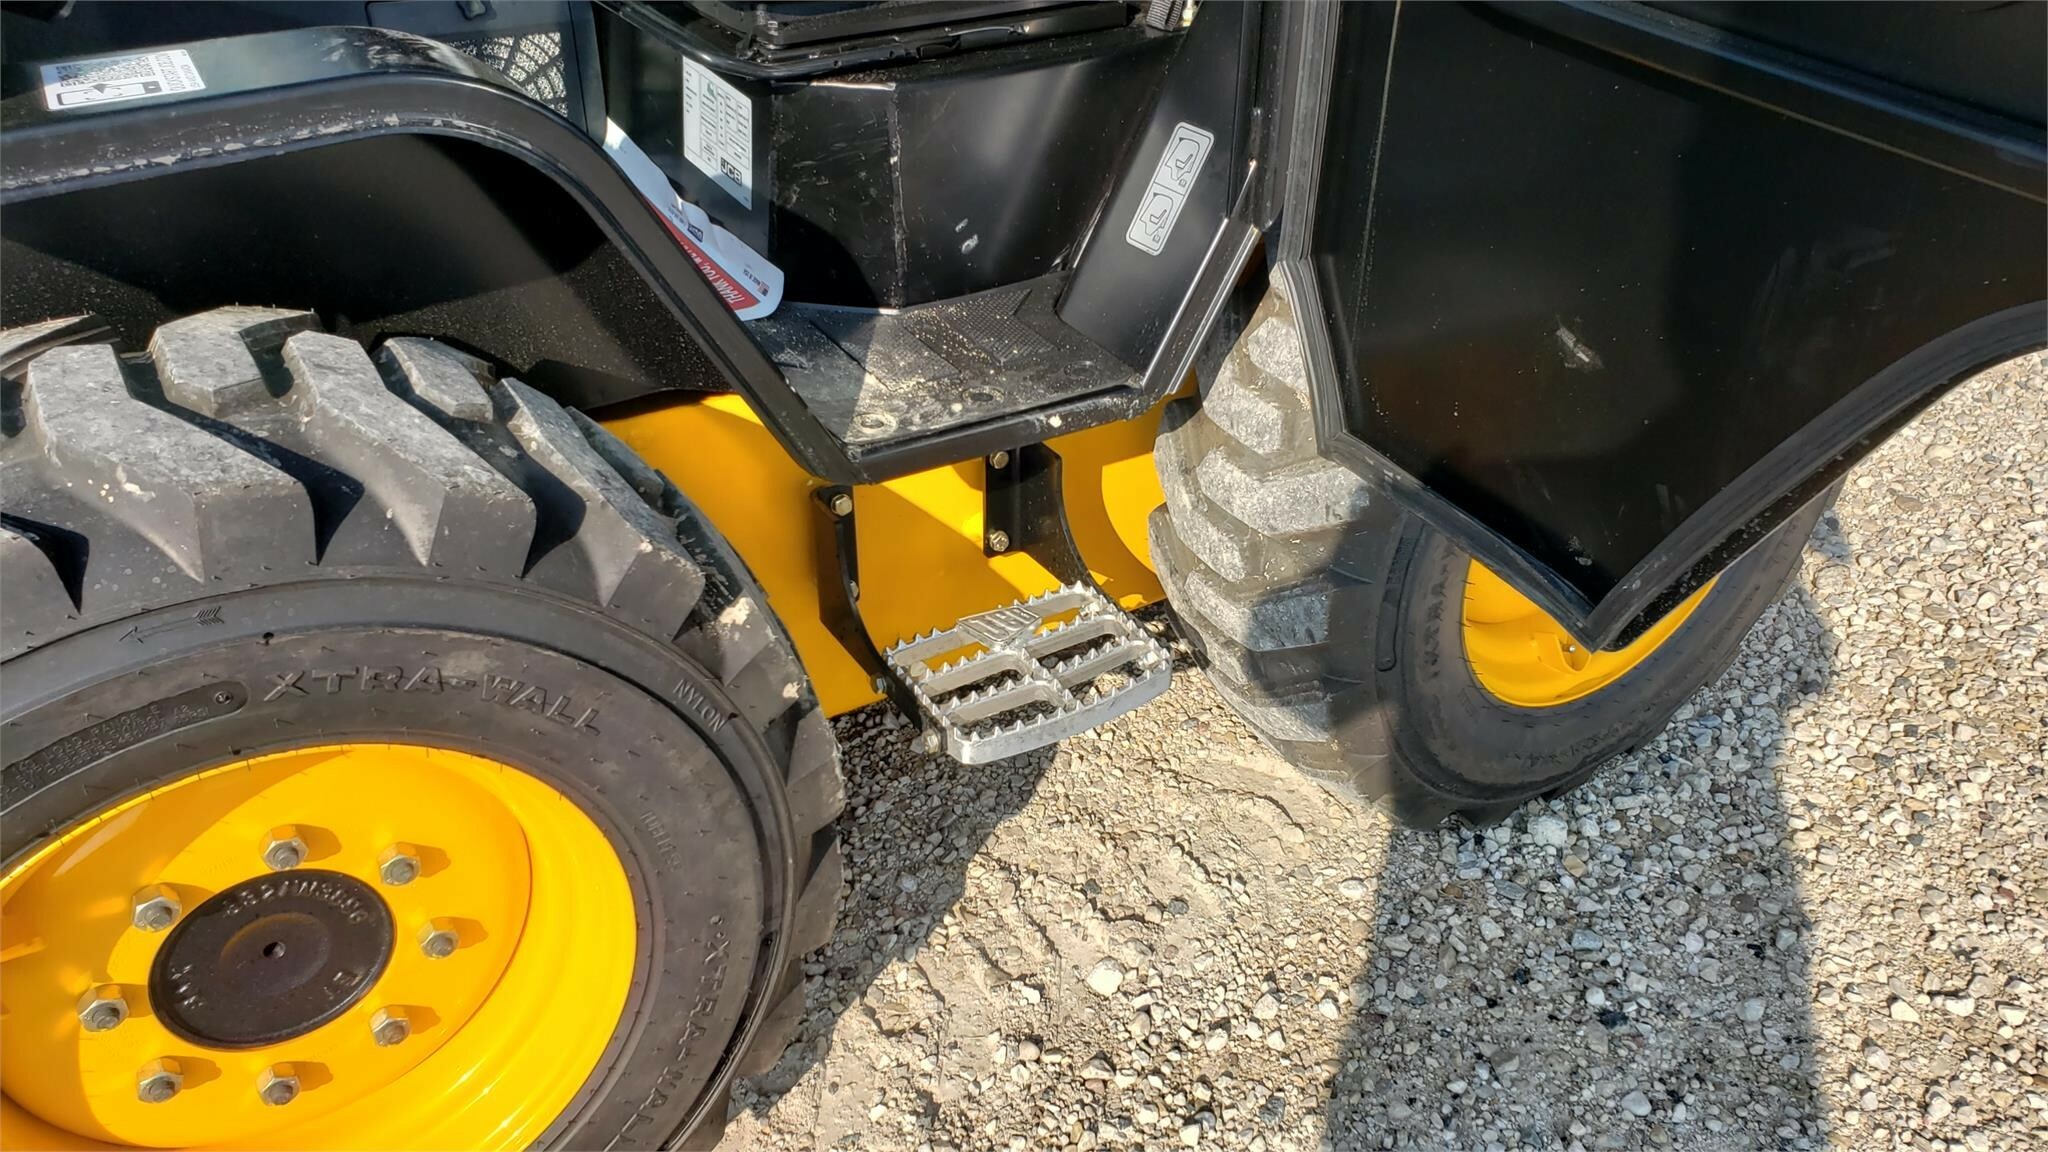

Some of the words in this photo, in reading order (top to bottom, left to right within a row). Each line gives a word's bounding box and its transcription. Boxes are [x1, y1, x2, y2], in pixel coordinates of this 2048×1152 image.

[721, 158, 743, 185] JCB
[713, 278, 745, 304] THANK
[966, 607, 1034, 642] JCB
[263, 665, 601, 737] XTRA-WALL
[672, 679, 726, 733] NYLON
